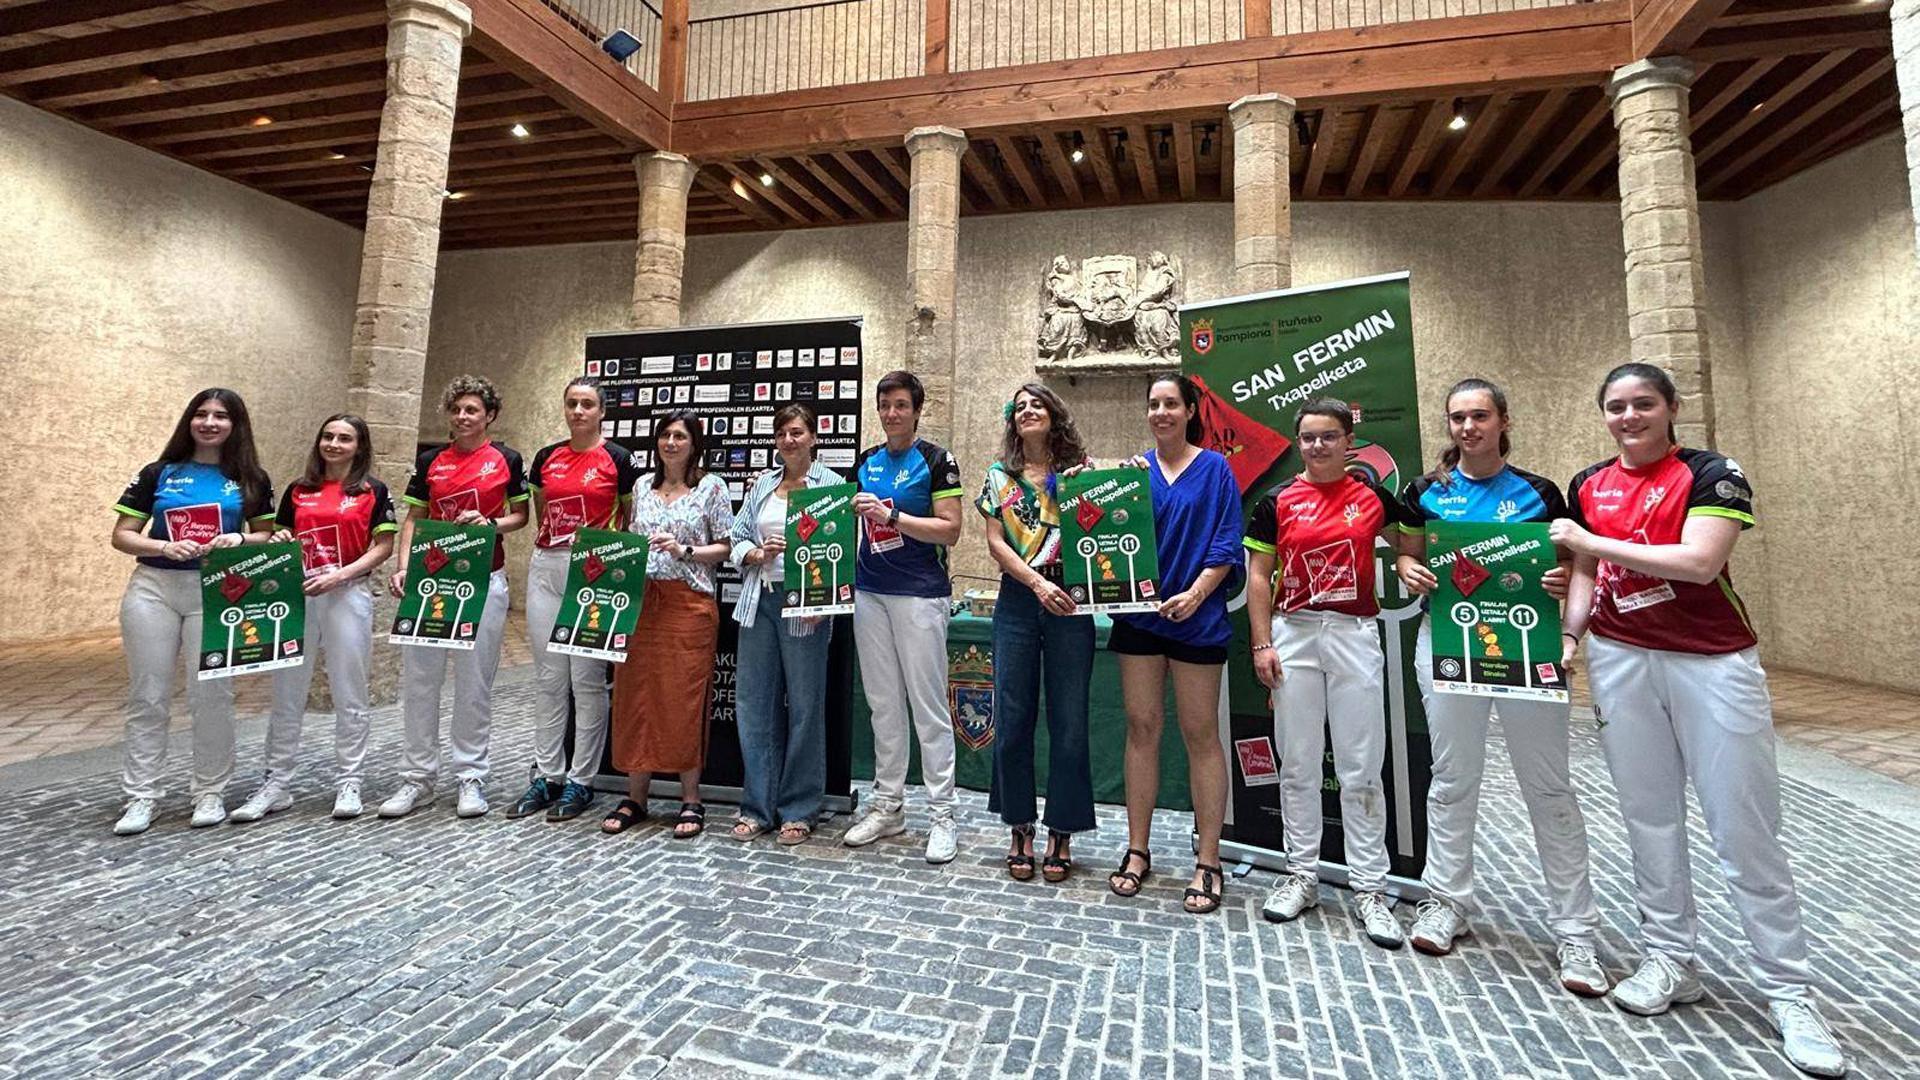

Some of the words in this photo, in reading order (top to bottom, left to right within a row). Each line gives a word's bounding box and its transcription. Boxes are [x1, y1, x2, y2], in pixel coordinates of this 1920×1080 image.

[1278, 314, 1322, 329] Iruñeko
[1216, 328, 1271, 344] Pamplona
[1231, 363, 1286, 403] SAN
[1292, 309, 1396, 373] FERMIN
[1267, 355, 1368, 411] Txapelketa
[824, 437, 856, 445] ELKARTEA
[1059, 496, 1081, 513] SAN
[1082, 478, 1118, 502] FERMIN
[1093, 480, 1141, 507] Txapelketa
[1437, 495, 1468, 504] berria
[1592, 488, 1623, 498] berria
[787, 511, 803, 525] SAN
[805, 494, 832, 515] FERMIN
[411, 543, 431, 554] SAN
[434, 532, 467, 548] FERMIN
[1083, 541, 1091, 553] 5
[1125, 539, 1134, 550] 11
[571, 550, 589, 562] SAN
[592, 541, 624, 556] FERMIN
[799, 550, 807, 560] 5
[830, 548, 839, 558] 11
[1429, 551, 1458, 569] SAN
[1460, 534, 1510, 559] FERMIN
[1475, 539, 1541, 567] Txapelketa
[202, 570, 226, 587] SAN
[228, 552, 269, 574] FERMIN
[423, 582, 432, 593] 5
[460, 586, 470, 596] 11
[582, 591, 590, 601] 5
[616, 596, 625, 607] 11
[228, 611, 237, 622] 5
[272, 606, 284, 617] 11
[1459, 607, 1471, 621] 5
[1515, 610, 1531, 624] 11
